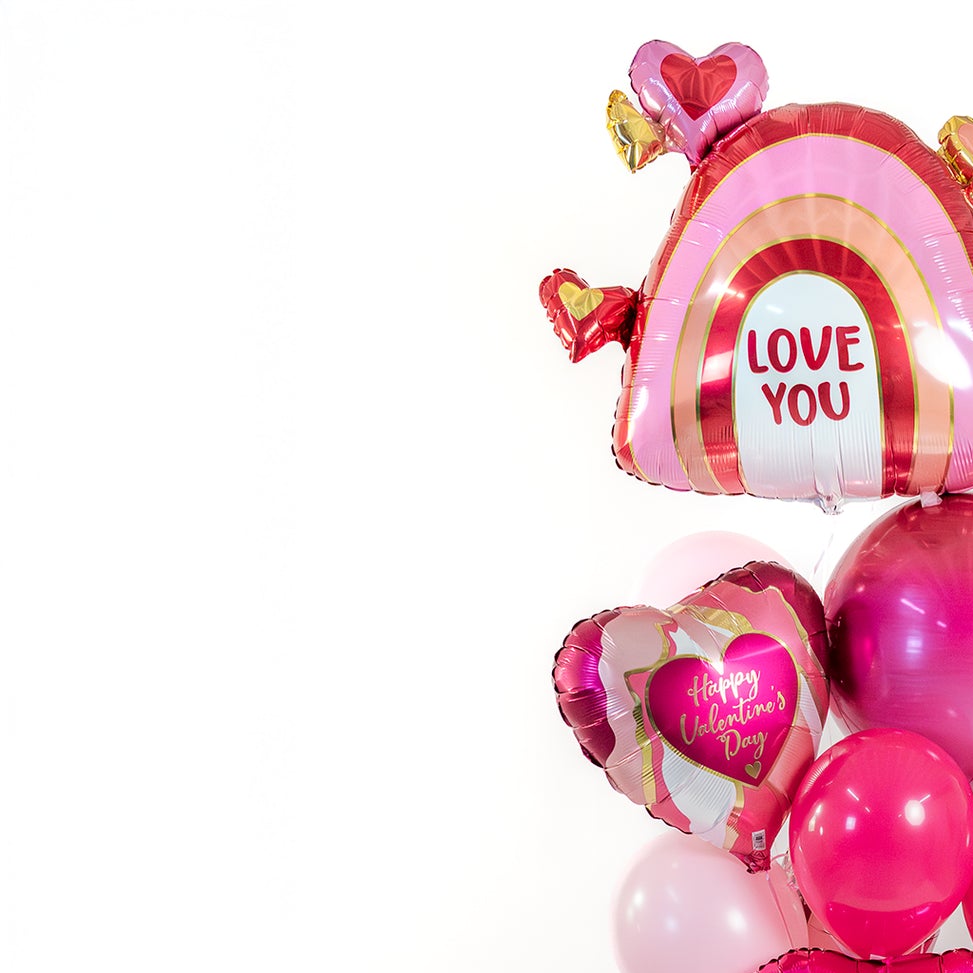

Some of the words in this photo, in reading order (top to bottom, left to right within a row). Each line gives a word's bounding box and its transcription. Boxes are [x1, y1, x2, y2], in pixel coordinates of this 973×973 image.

[748, 326, 864, 373] LOVE
[761, 381, 850, 426] YOU
[687, 669, 760, 707] Happy
[680, 686, 786, 745] Valentine's
[716, 730, 768, 760] Day
